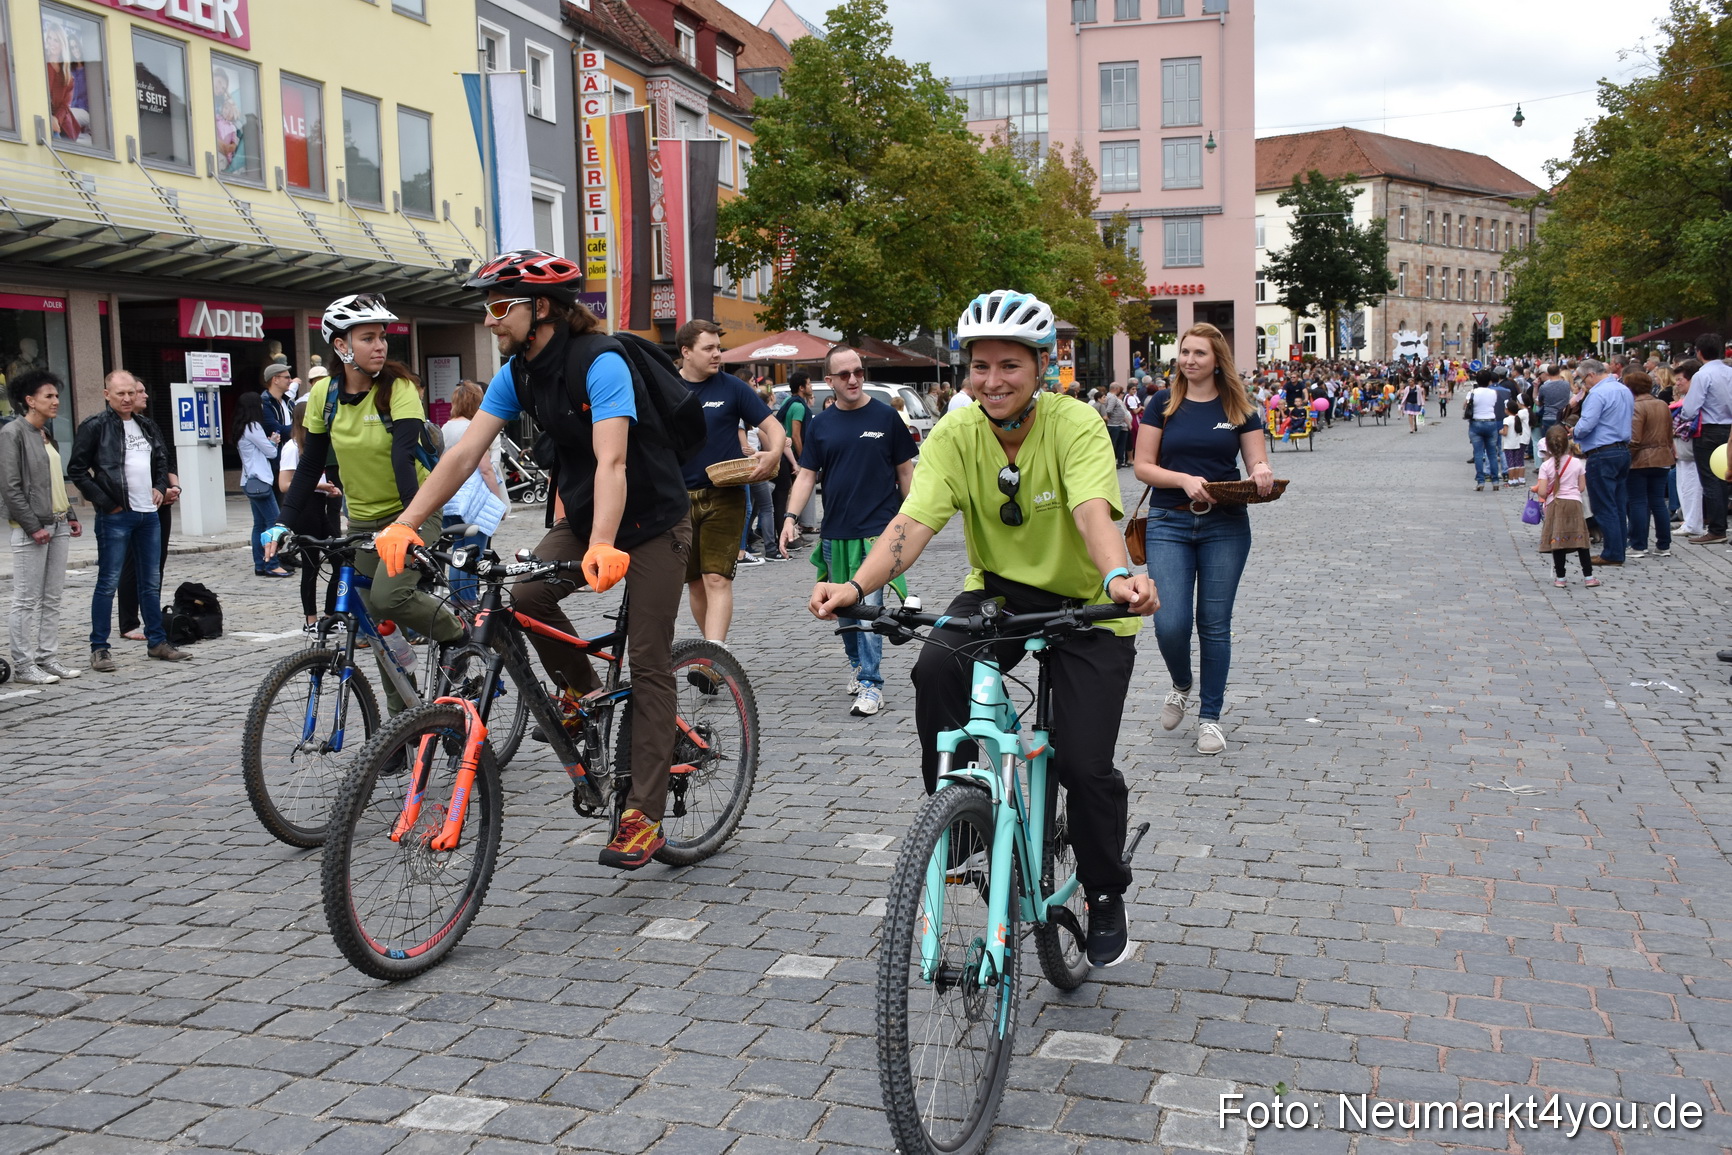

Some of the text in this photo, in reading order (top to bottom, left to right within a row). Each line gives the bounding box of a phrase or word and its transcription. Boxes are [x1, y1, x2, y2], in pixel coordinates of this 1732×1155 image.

[145, 91, 167, 107] SEITE
[43, 300, 62, 308] ADLER
[191, 301, 265, 339] ADLER
[198, 393, 216, 401] HIR
[181, 401, 191, 418] P
[1007, 921, 1020, 1036] SCHWALBE
